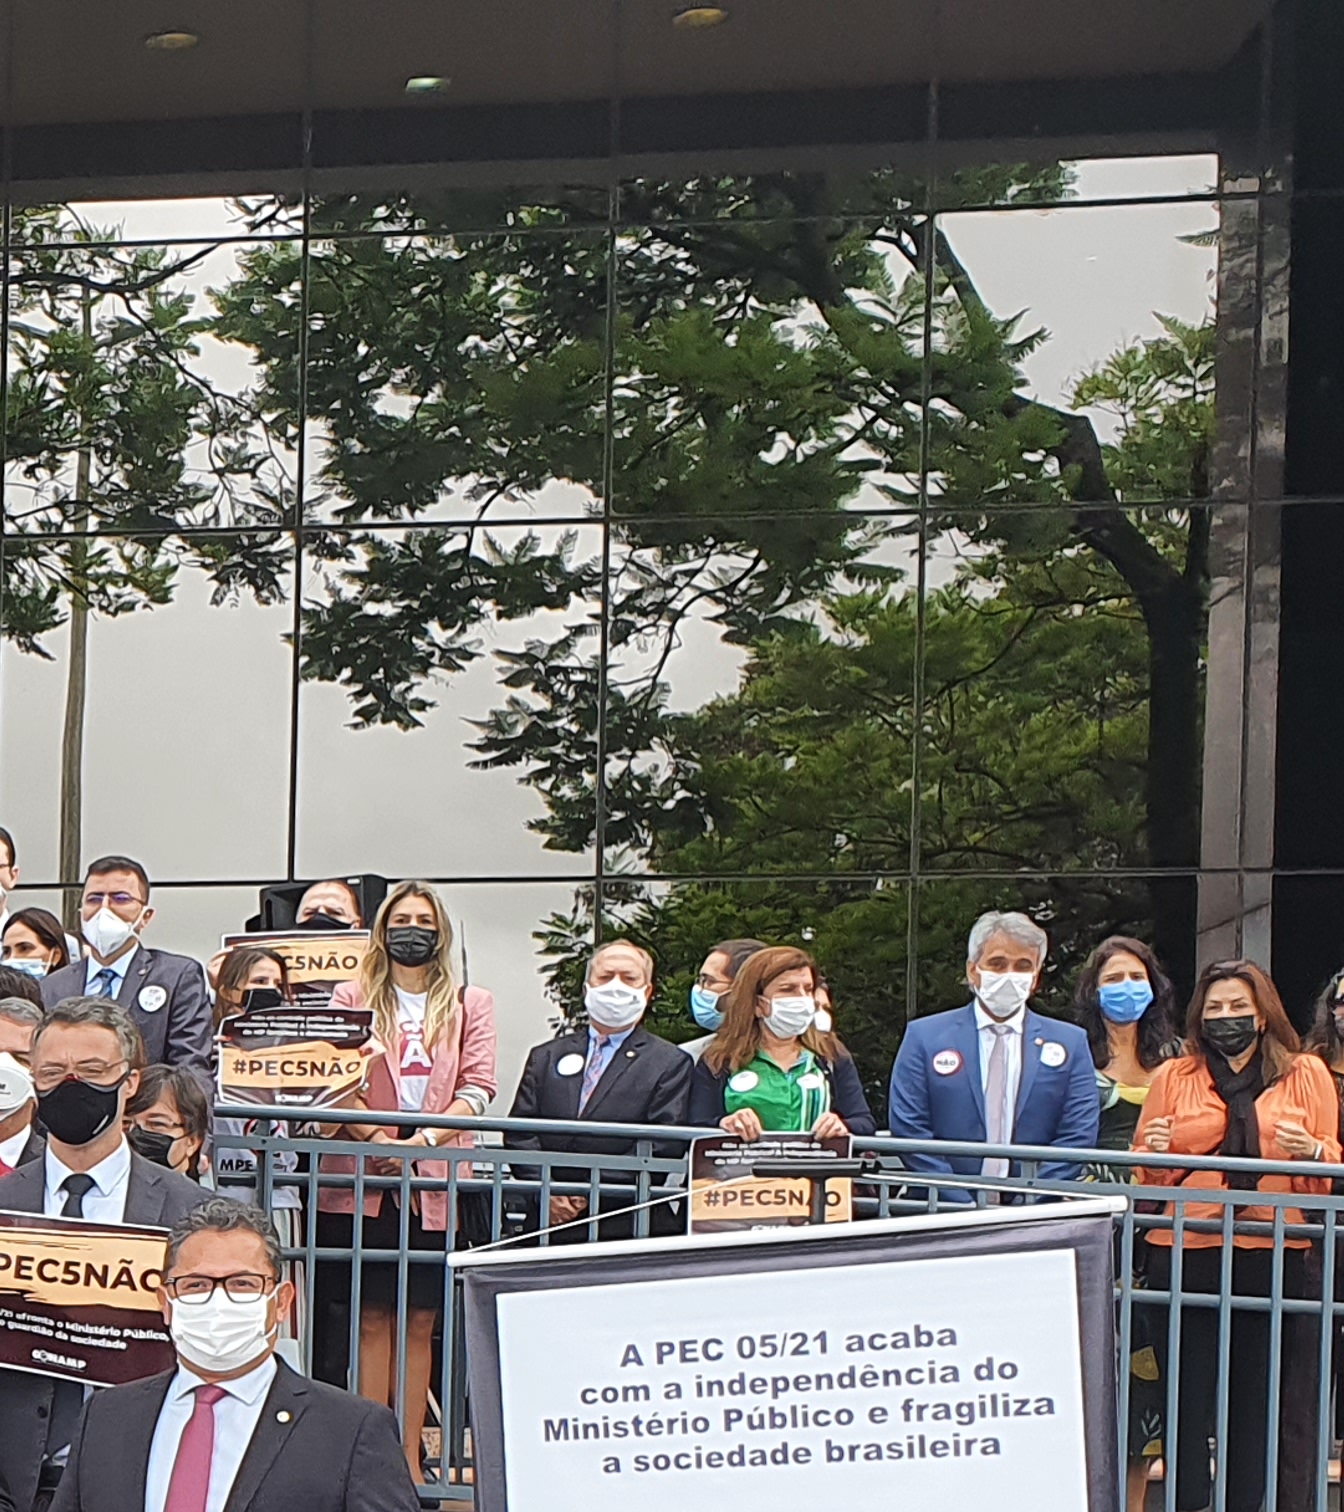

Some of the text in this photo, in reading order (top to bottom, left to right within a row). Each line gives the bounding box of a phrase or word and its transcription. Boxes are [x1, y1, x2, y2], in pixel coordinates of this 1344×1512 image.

[232, 1058, 360, 1077] #PEC5NÃO
[704, 1189, 841, 1207] #PEC5NO
[620, 1325, 957, 1367] A PEC 05/21 acaba
[580, 1356, 1019, 1405] com a independência do
[544, 1392, 1055, 1442] Ministério Público e fragiliza
[602, 1434, 1001, 1474] a sociedade brasileira
